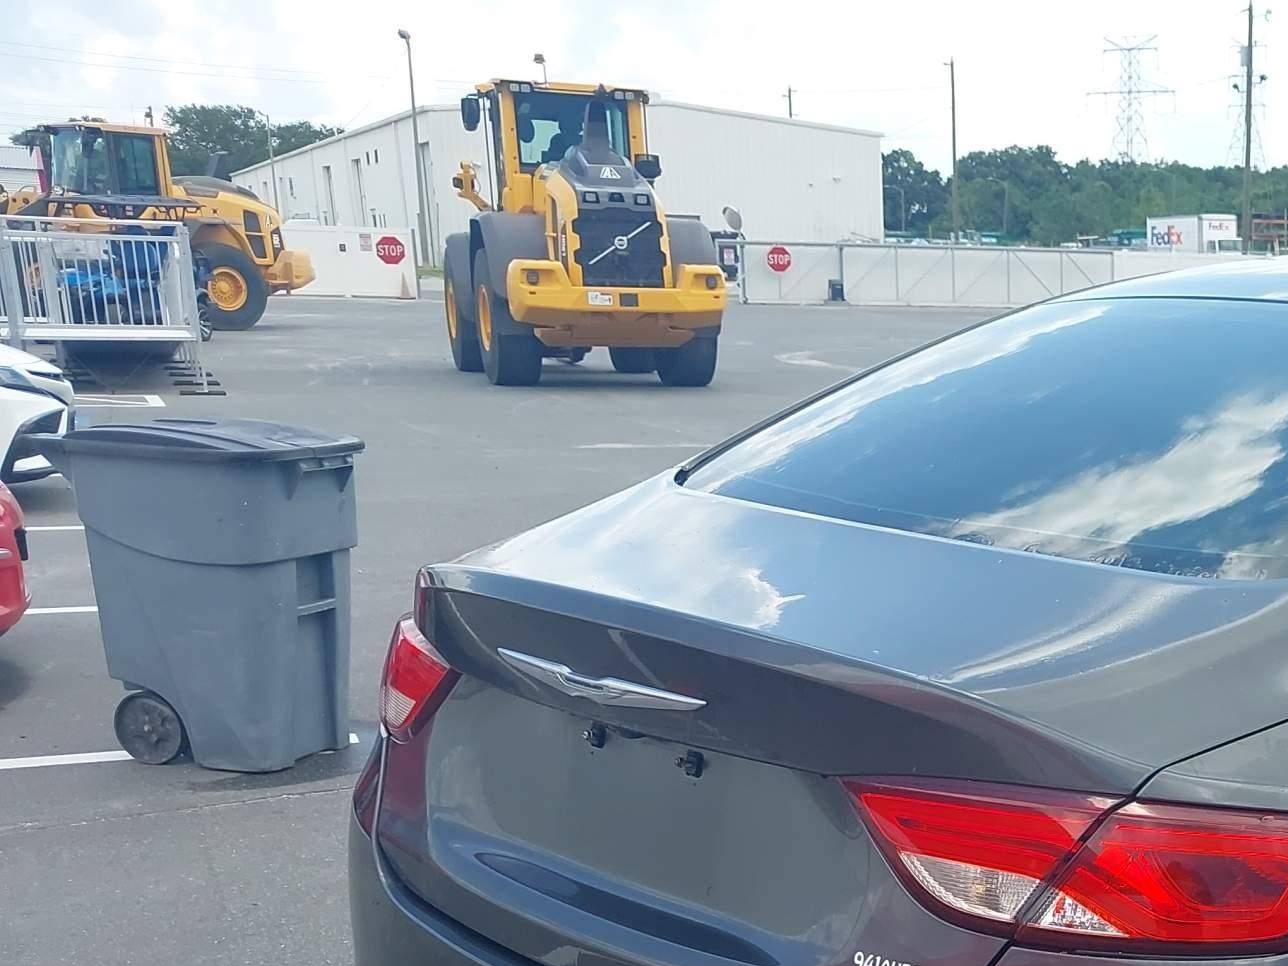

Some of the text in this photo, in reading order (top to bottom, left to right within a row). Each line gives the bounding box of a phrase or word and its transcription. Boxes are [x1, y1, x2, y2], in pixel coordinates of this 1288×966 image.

[1151, 225, 1183, 246] FedEx
[377, 244, 403, 257] STOP
[768, 254, 791, 265] STOP
